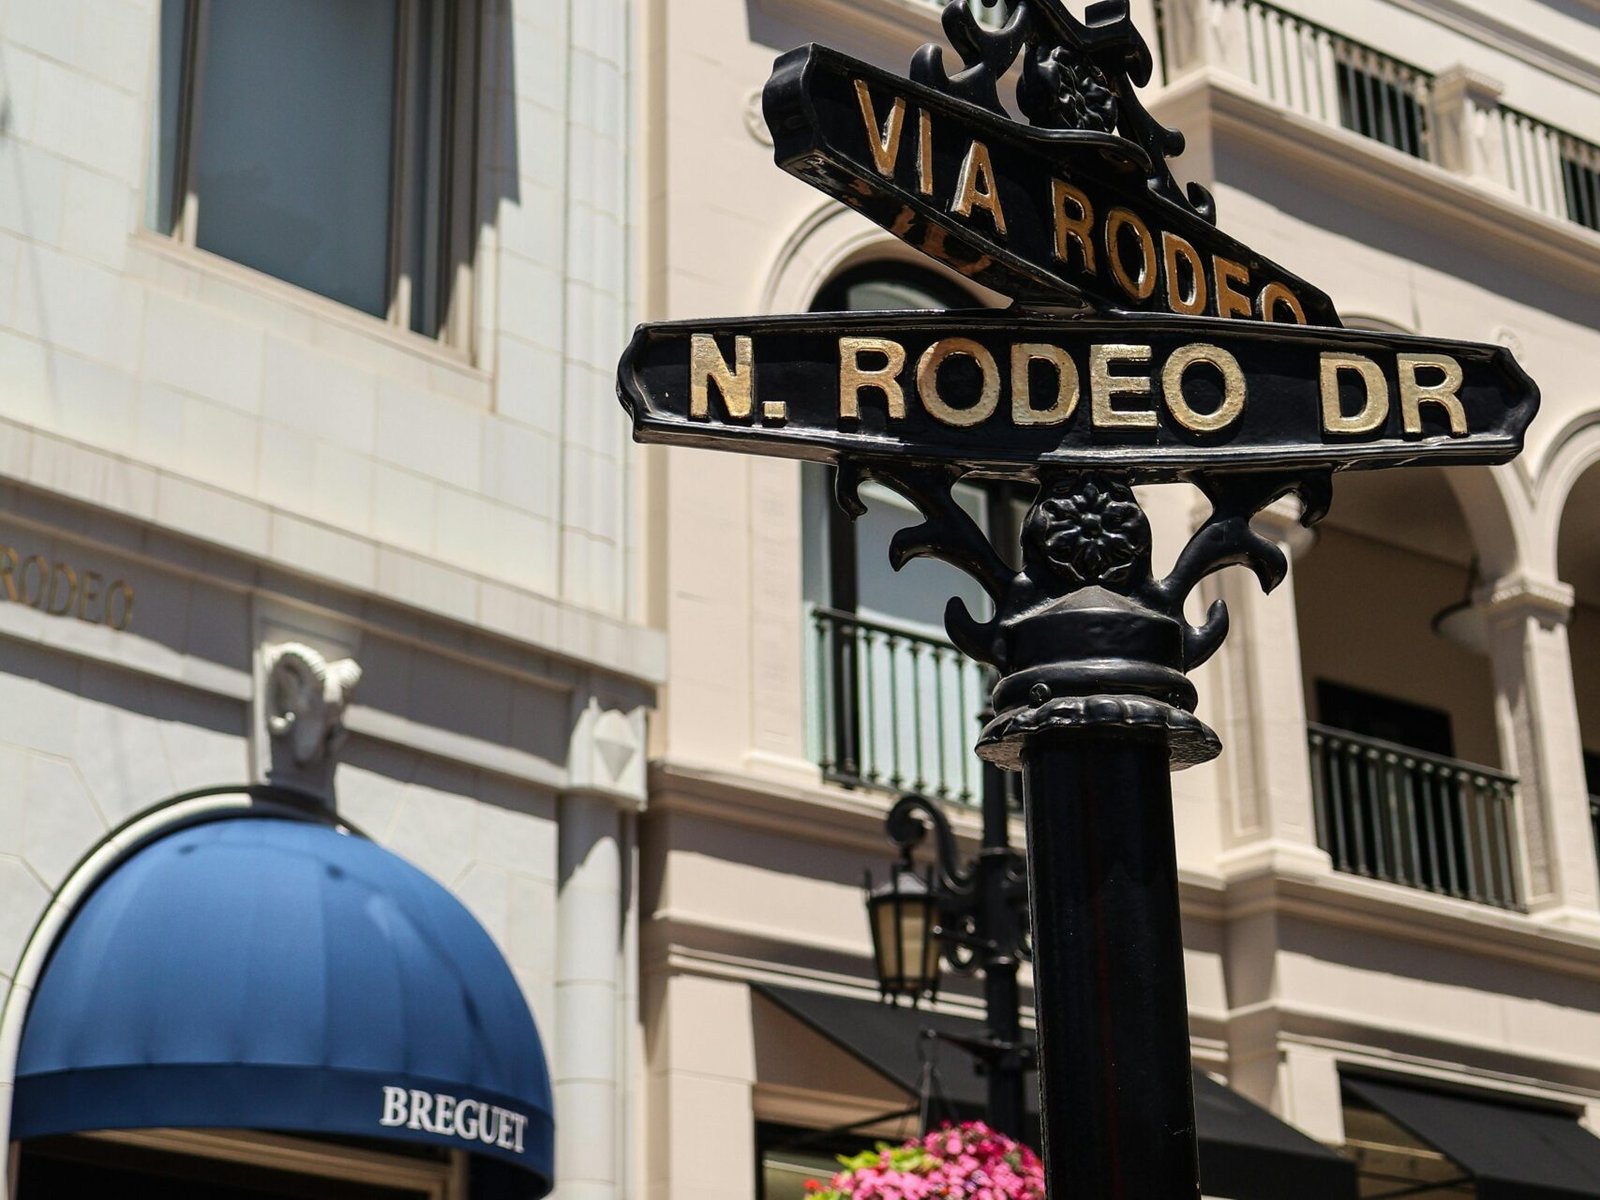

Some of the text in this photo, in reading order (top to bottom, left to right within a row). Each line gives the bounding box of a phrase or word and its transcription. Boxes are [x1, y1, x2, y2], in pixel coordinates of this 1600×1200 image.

[854, 79, 1007, 235] VIA
[689, 333, 1470, 437] N. RODEO DR
[0, 544, 134, 631] RODEO
[379, 1085, 528, 1154] BREGUET
